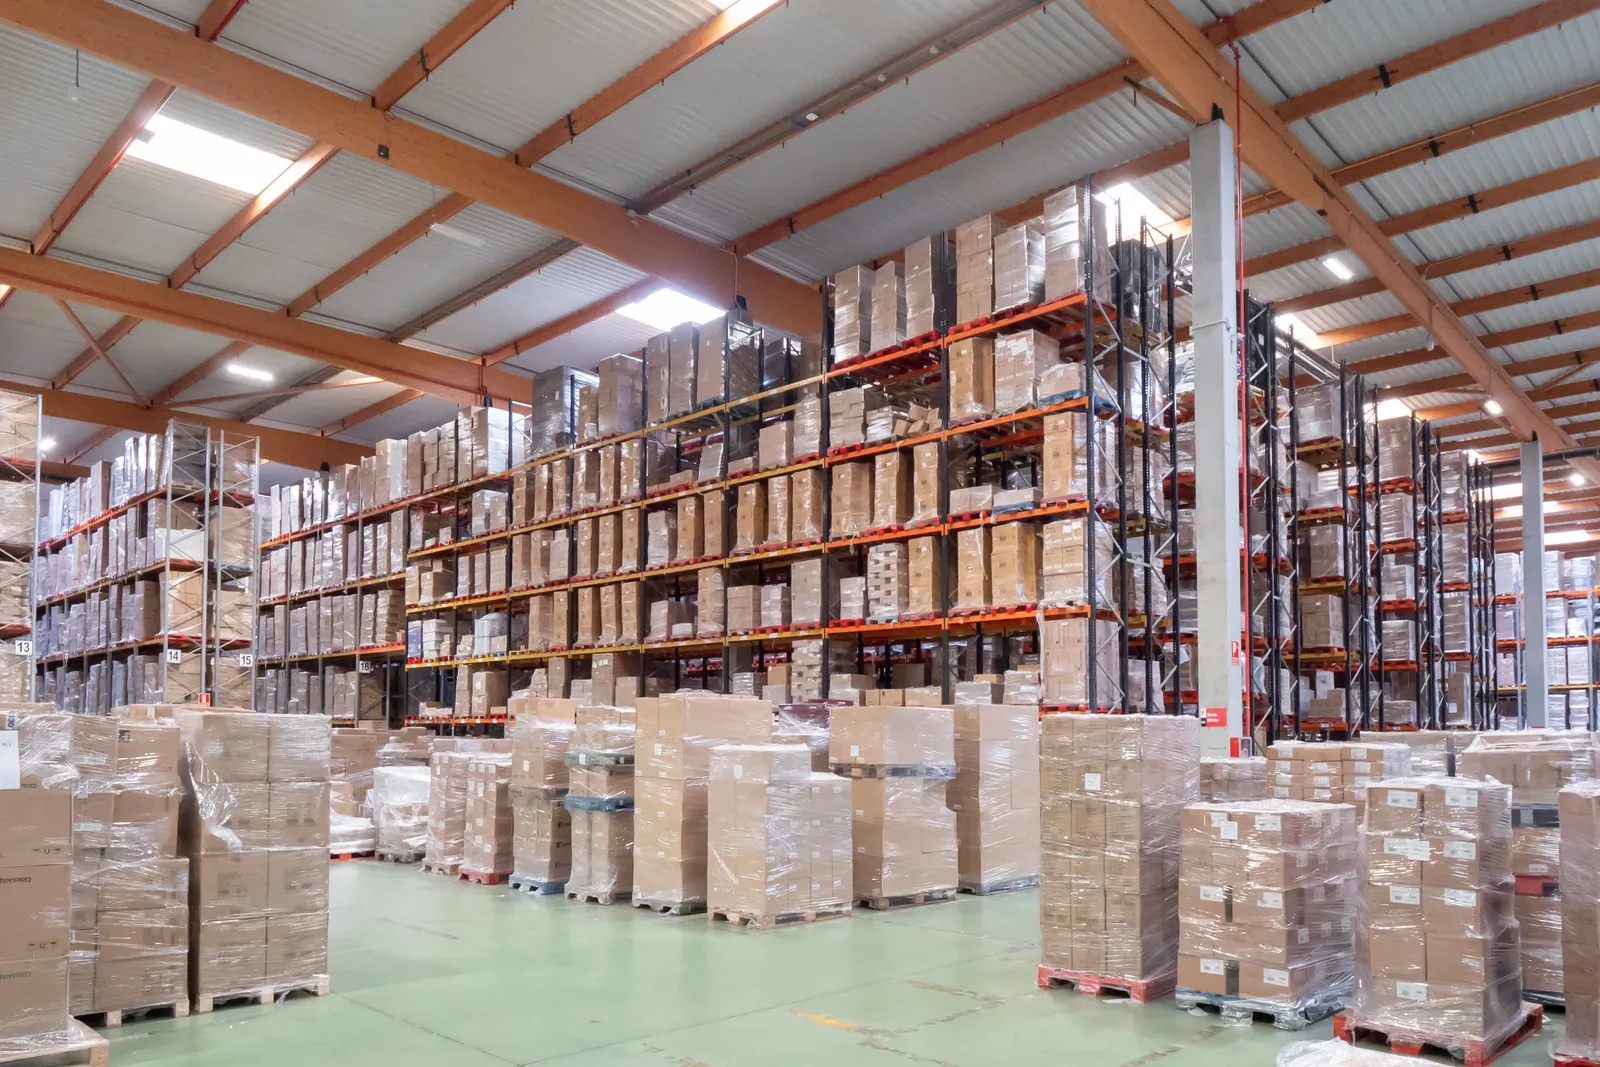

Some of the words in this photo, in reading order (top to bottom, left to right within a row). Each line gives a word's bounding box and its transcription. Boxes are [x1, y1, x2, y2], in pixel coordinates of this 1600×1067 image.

[17, 642, 30, 652] 13
[168, 651, 179, 660] 14
[241, 655, 252, 665] 15
[360, 662, 370, 671] 16
